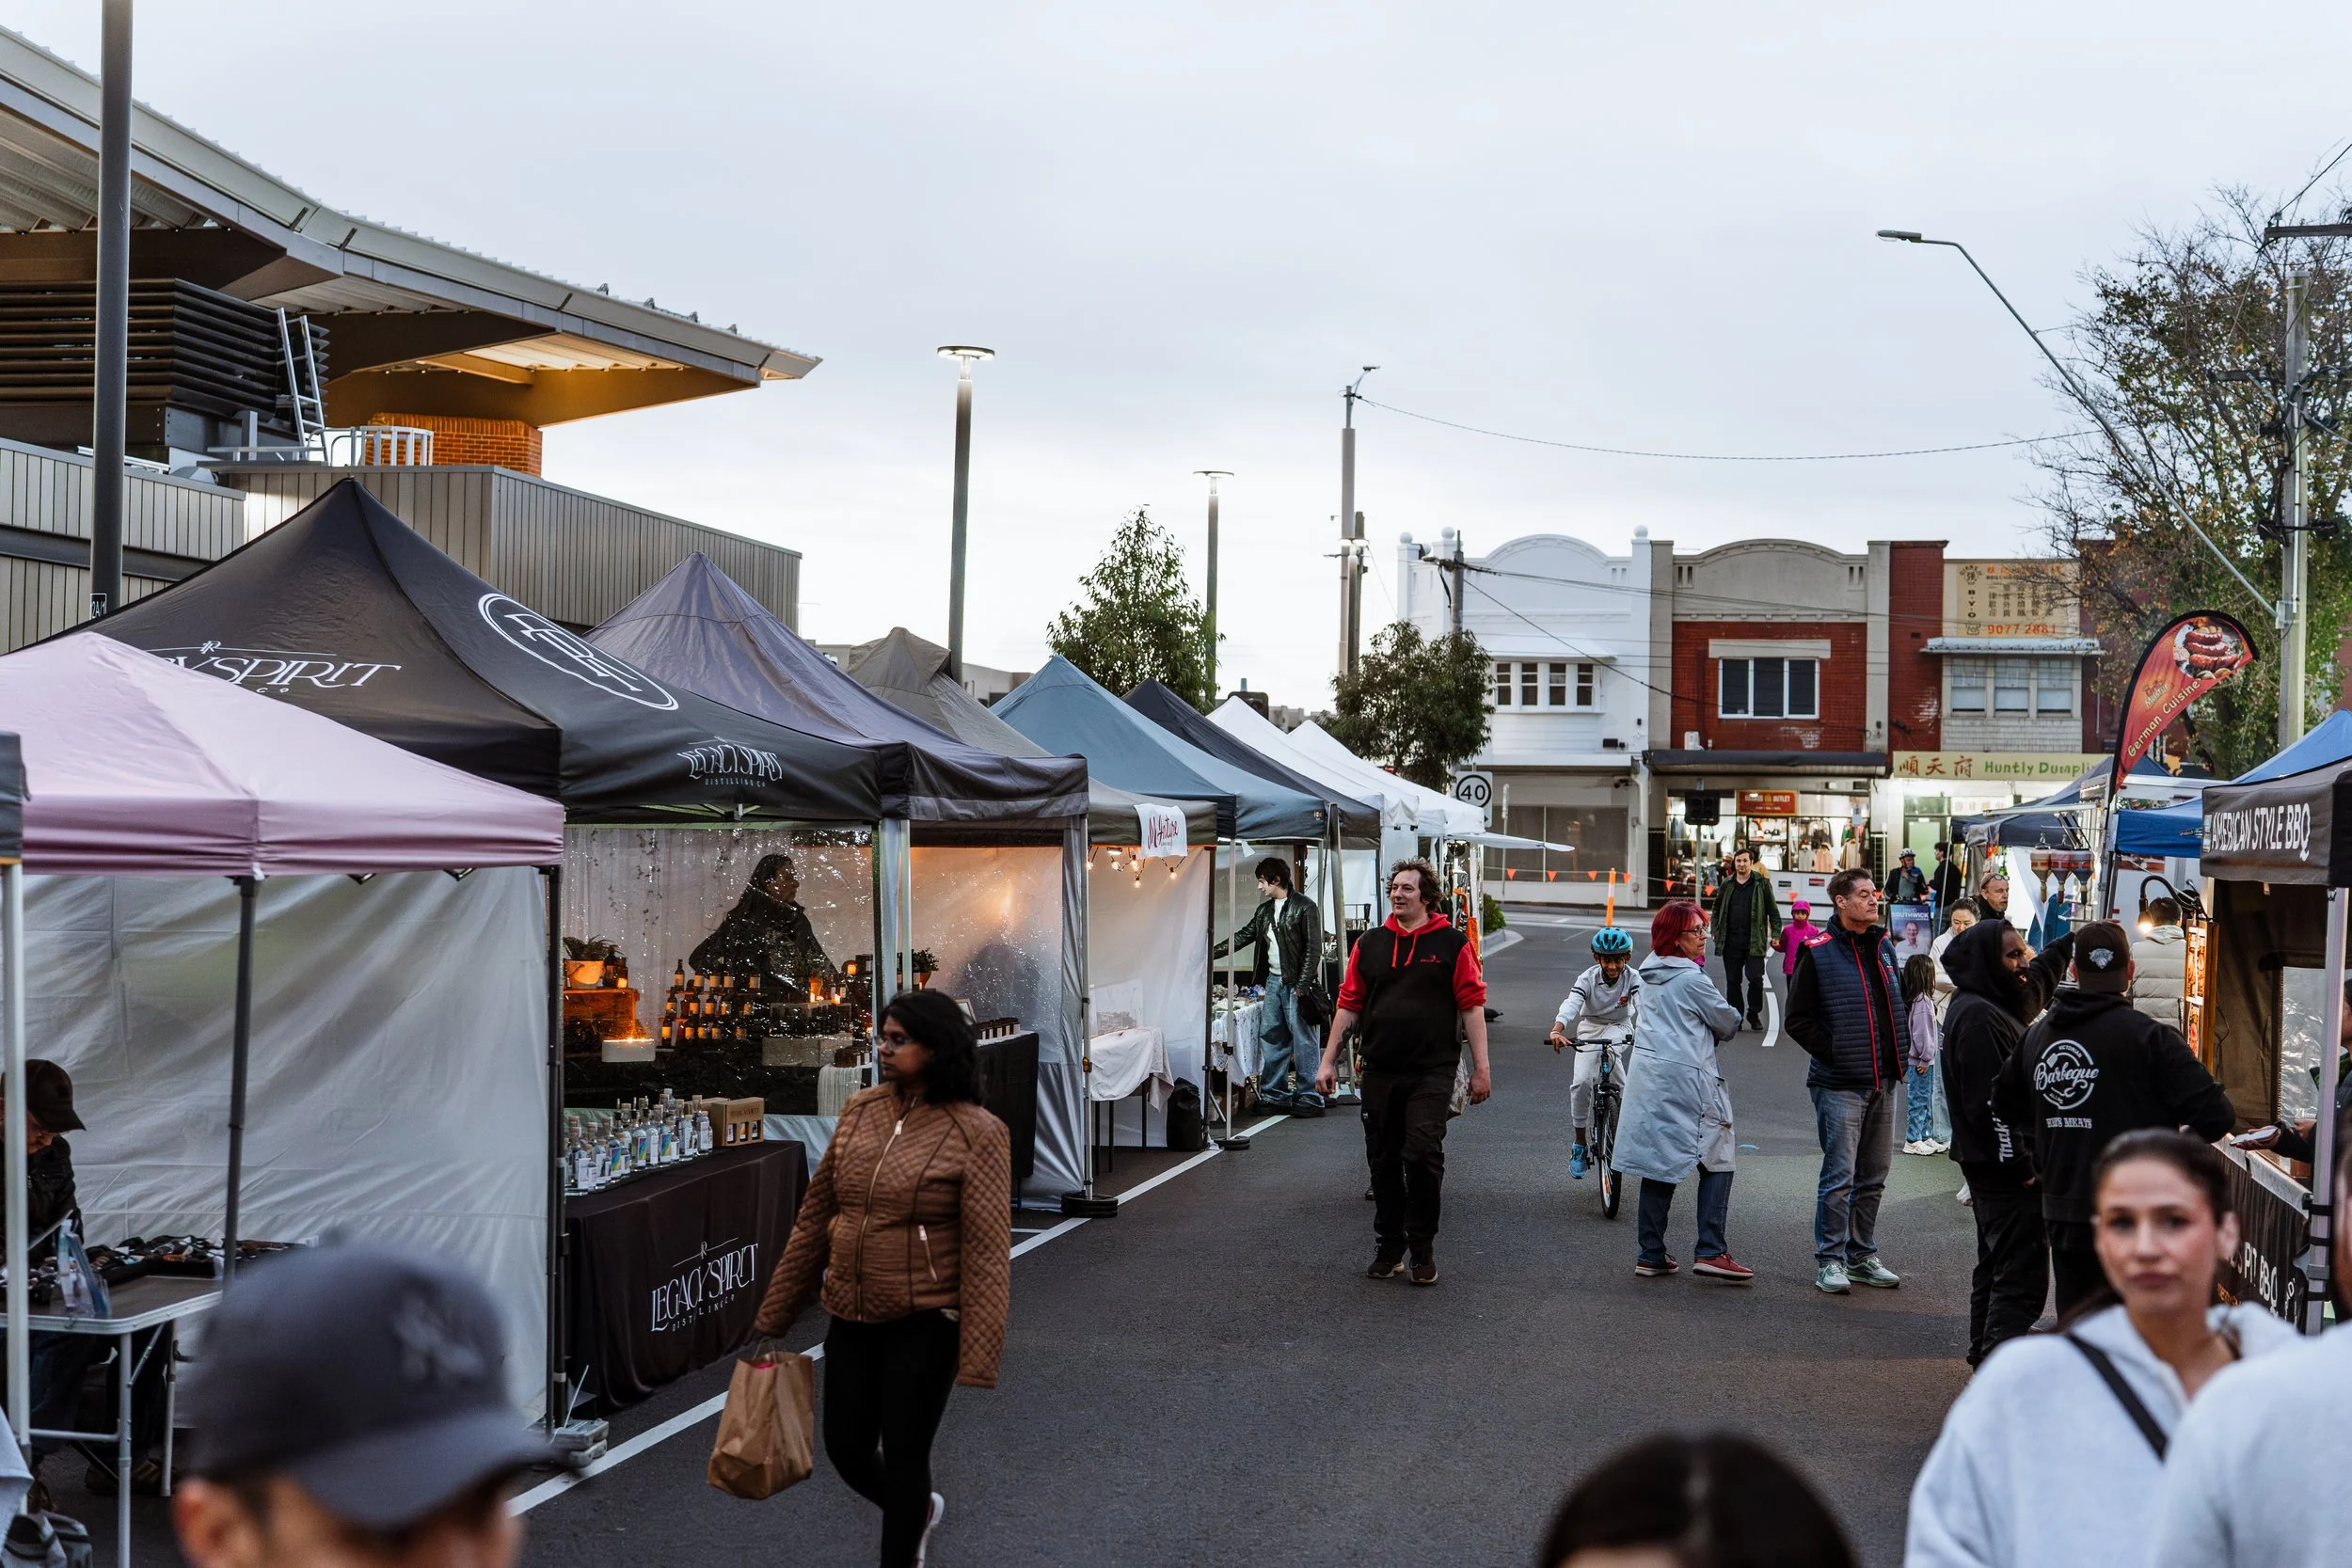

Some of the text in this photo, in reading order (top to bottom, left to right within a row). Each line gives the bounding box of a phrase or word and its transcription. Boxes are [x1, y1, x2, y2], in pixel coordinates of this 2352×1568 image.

[1987, 624, 2020, 635] 9077
[213, 657, 402, 689] SPIRIT
[2127, 680, 2201, 757] German Cuisine
[1899, 755, 1973, 778] 順天府
[1984, 760, 2034, 776] Huntly
[1460, 784, 1486, 800] 40
[2212, 802, 2311, 862] AMERICAN STYLE BBQ
[2033, 1061, 2100, 1091] Barbeque
[651, 1243, 758, 1332] LEGACY SPIRIT
[2244, 1242, 2278, 1317] PIT BBQ
